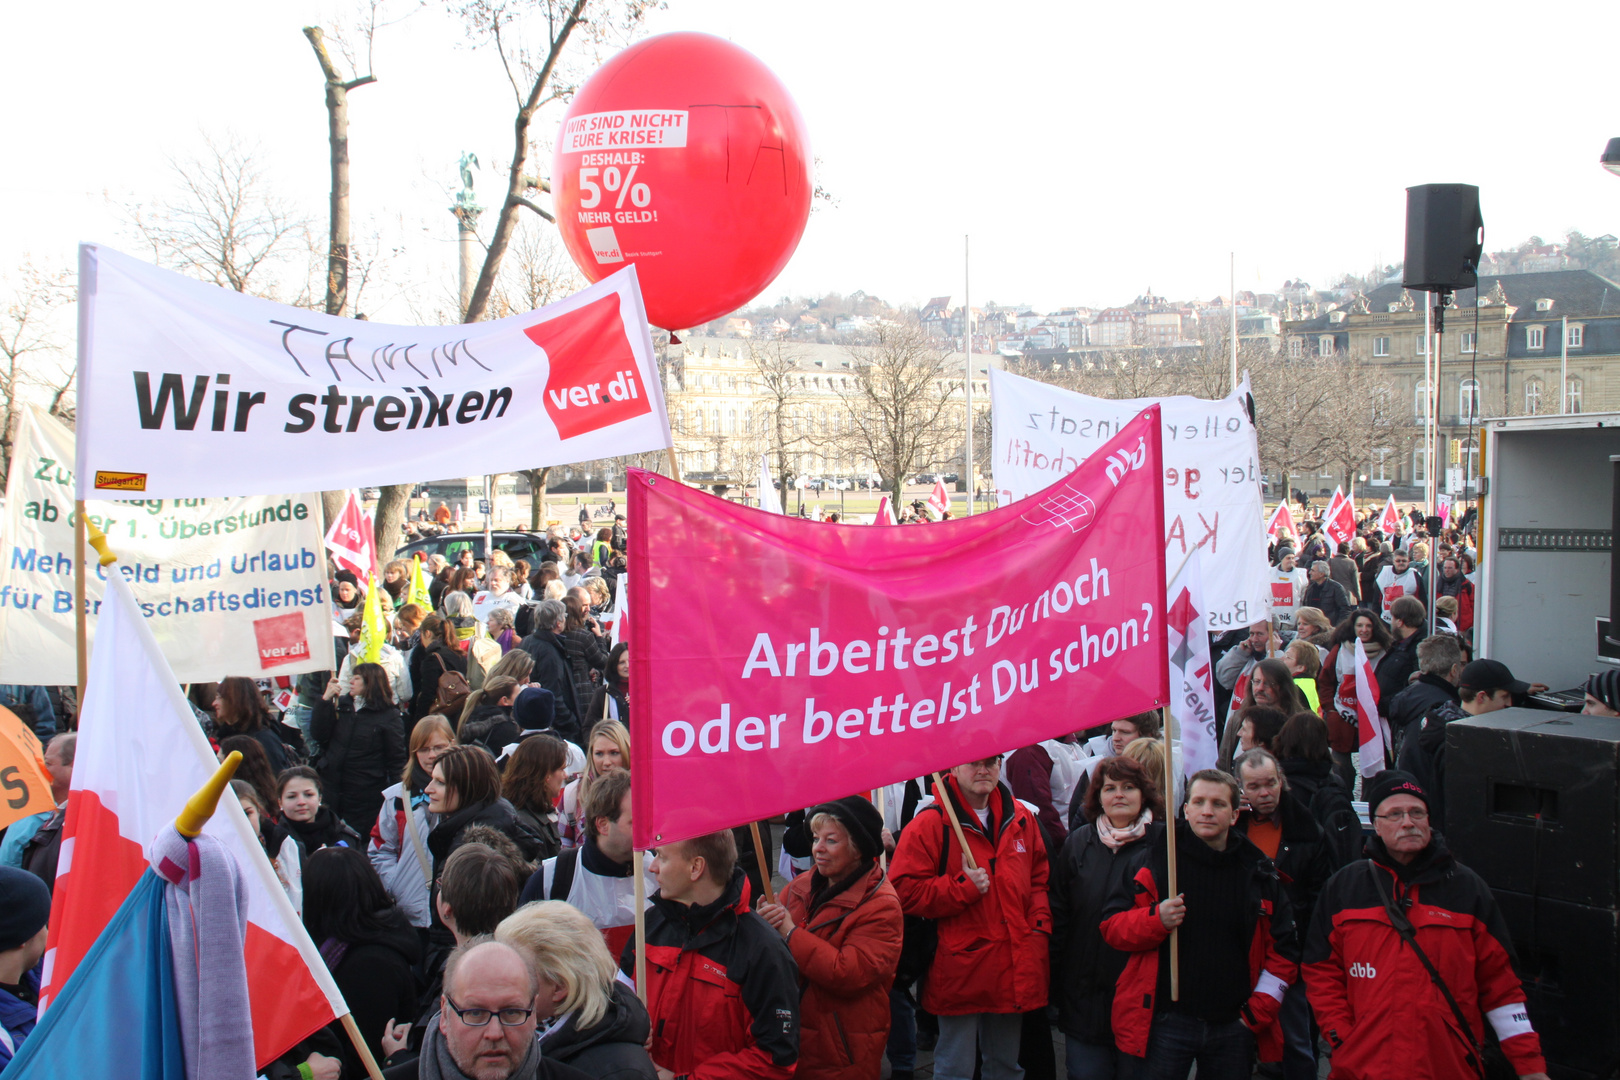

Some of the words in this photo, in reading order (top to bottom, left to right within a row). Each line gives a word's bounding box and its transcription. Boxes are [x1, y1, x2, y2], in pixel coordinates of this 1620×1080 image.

[568, 119, 587, 134] WIR
[589, 115, 625, 131] SIND
[630, 113, 684, 128] NICHT
[572, 132, 604, 148] EURE
[608, 130, 663, 145] KRISE!
[582, 152, 645, 166] DESHALB:
[579, 165, 651, 209] 5%
[578, 211, 612, 223] MEHR
[615, 210, 658, 224] GELD!
[594, 248, 620, 258] ver.di
[270, 320, 493, 383] TAMM
[133, 370, 266, 432] Wir
[284, 384, 513, 434] streiken
[549, 370, 638, 411] ver.di
[34, 456, 76, 487] Zu
[97, 475, 134, 487] Stuttgart
[134, 478, 143, 486] 21
[24, 499, 59, 523] ab
[127, 518, 147, 539] 1.
[159, 498, 308, 540] Überstunde
[11, 546, 88, 576] Meh
[172, 558, 221, 583] und
[231, 547, 316, 575] Urlaub
[0, 585, 42, 610] für
[741, 615, 976, 679] Arbeitest
[985, 604, 1030, 647] Du
[1033, 557, 1109, 624] noch
[262, 642, 305, 659] ver.di
[661, 703, 787, 757] oder
[802, 676, 983, 744] bettelst
[991, 659, 1040, 705] Du
[1049, 602, 1154, 682] schon?
[1402, 781, 1423, 794] dbb
[1350, 962, 1377, 979] dbb
